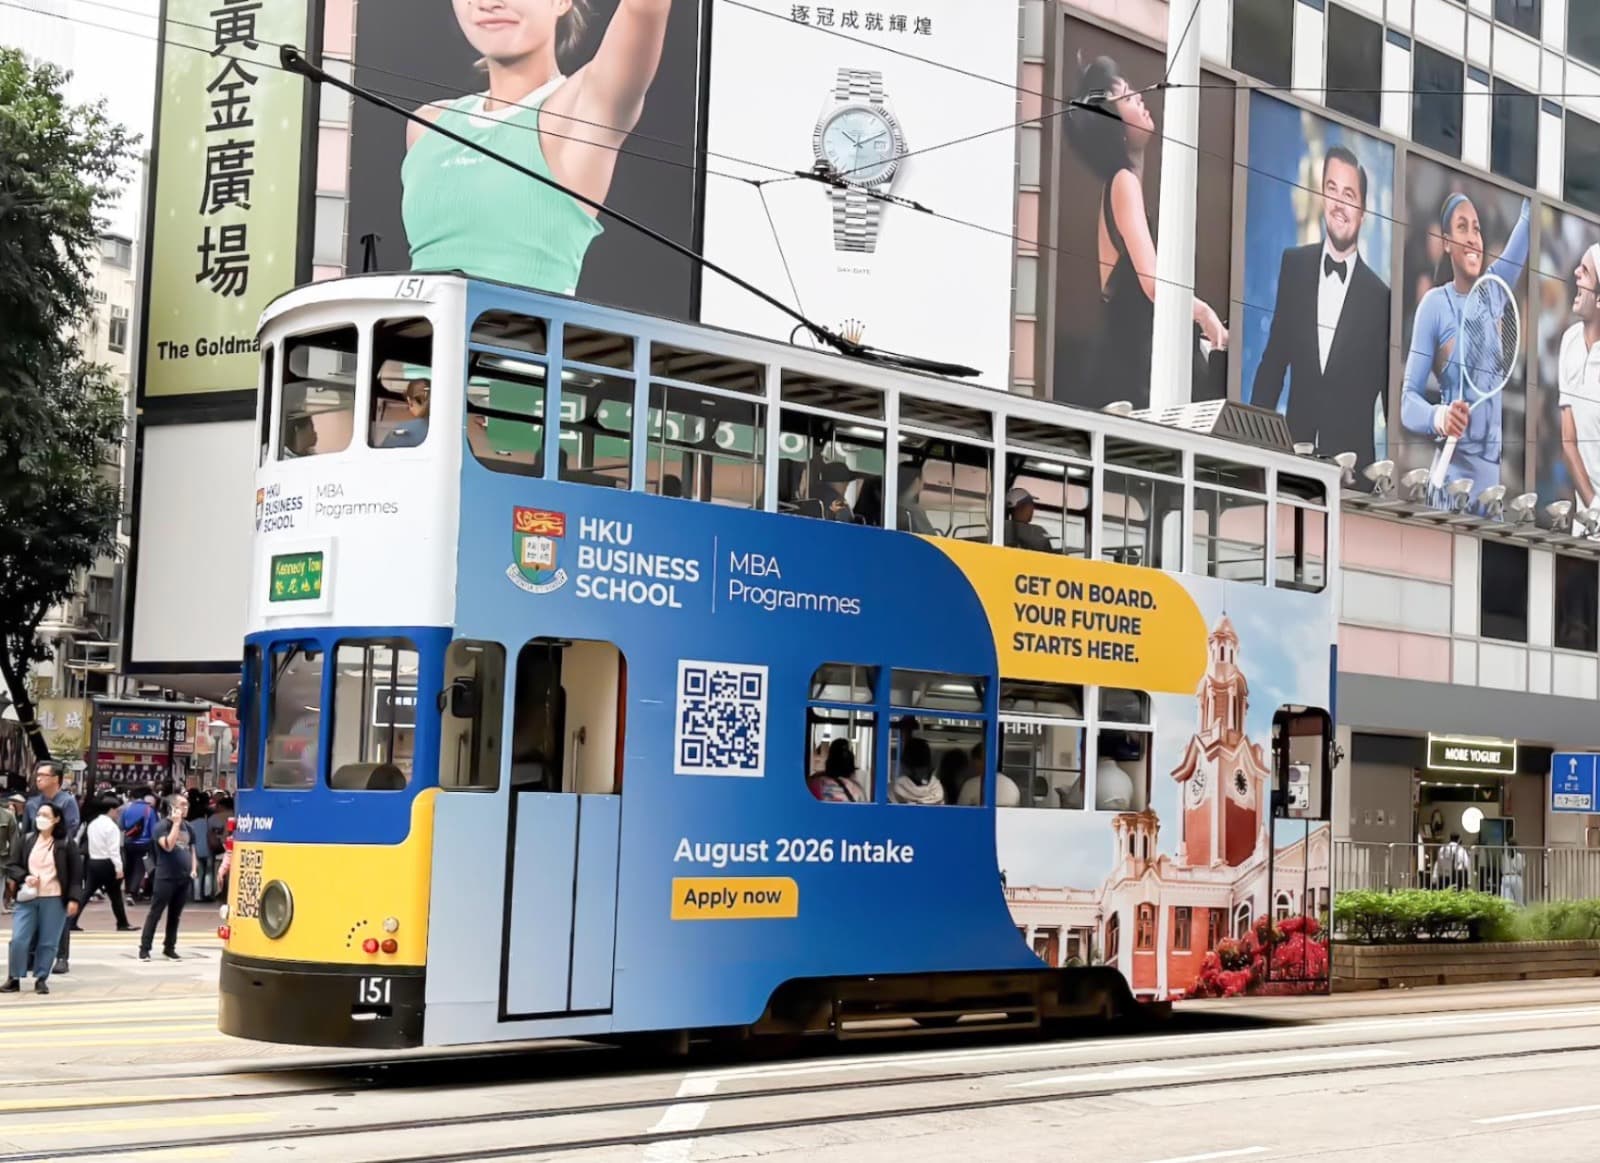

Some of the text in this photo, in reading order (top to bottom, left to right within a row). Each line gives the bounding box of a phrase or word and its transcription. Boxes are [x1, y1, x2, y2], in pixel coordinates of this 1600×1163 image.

[791, 4, 932, 35] 逐冠成就輝煌
[394, 278, 424, 299] 151
[157, 340, 189, 360] The
[316, 483, 344, 498] MBA
[265, 496, 303, 516] BUSINESS
[315, 502, 399, 519] Programmes
[263, 515, 295, 533] SCHOOL
[579, 516, 634, 545] HKU
[577, 545, 701, 583] BUSINESS
[729, 550, 782, 579] MBA
[575, 575, 683, 609] SCHOOL
[728, 579, 861, 616] Programmes
[1015, 574, 1157, 610] GET ON BOARD.
[1014, 602, 1141, 636] YOUR FUTURE
[1013, 631, 1139, 663] STARTS HERE.
[254, 817, 274, 830] now
[673, 837, 914, 868] August 2026 Intake
[683, 887, 782, 908] Apply now
[360, 977, 391, 1003] 151
